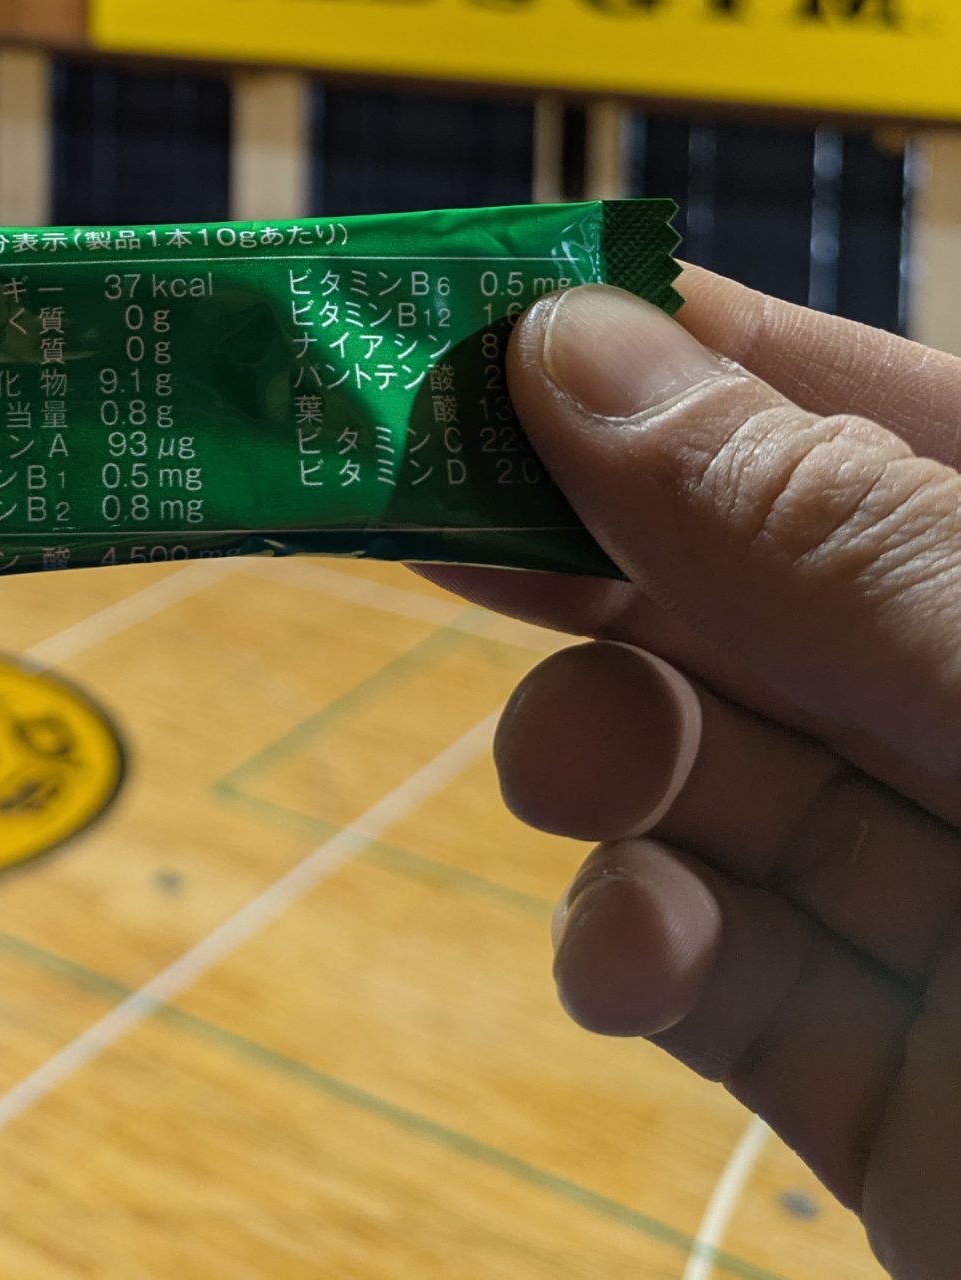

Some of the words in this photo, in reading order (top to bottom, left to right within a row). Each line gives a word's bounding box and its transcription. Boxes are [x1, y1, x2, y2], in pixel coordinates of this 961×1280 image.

[104, 274, 141, 301] 37
[152, 271, 214, 298] kcal
[480, 271, 525, 297] 0.5
[152, 307, 171, 332] g
[154, 340, 172, 364] g
[293, 332, 452, 360] ナイアシン
[99, 369, 141, 394] 9.1
[155, 373, 173, 396] g
[100, 401, 147, 426] 0.8
[156, 404, 174, 428] g
[108, 432, 148, 458] 93
[102, 463, 149, 489] 0.5
[159, 466, 203, 491] mg
[102, 495, 149, 521] 0.8
[160, 498, 204, 524] mg
